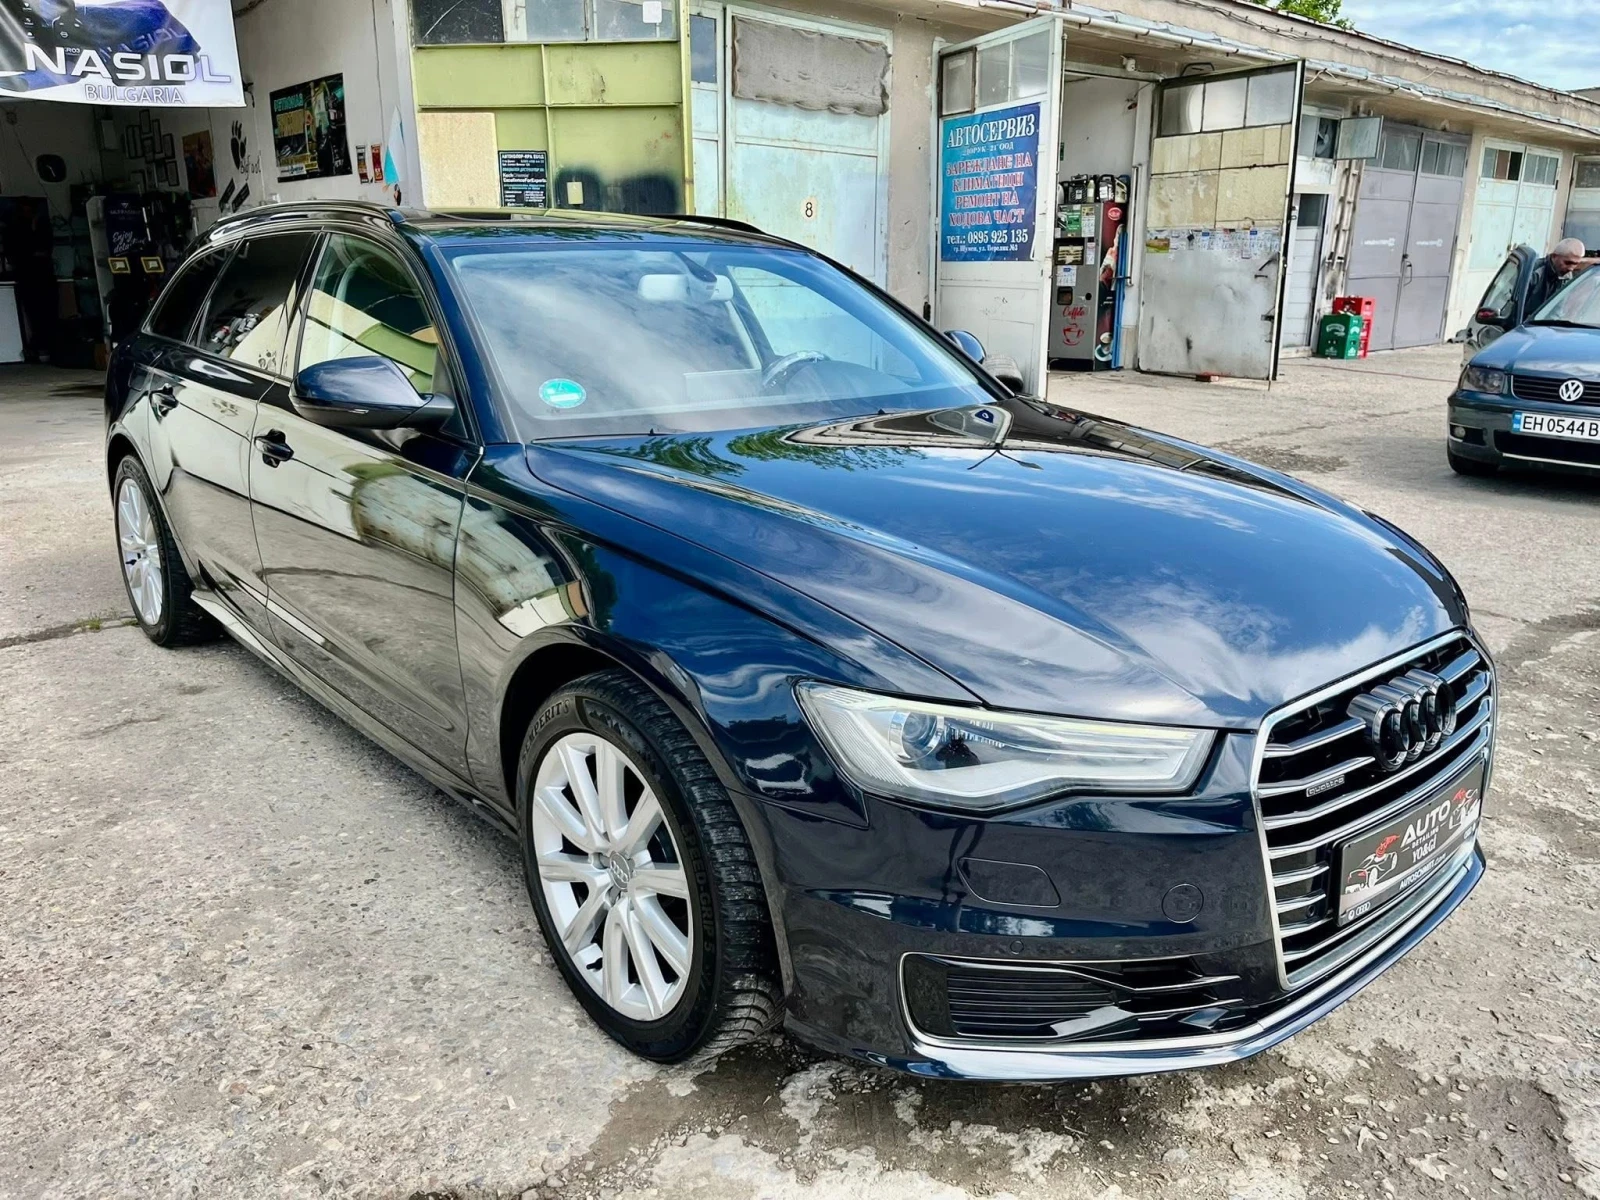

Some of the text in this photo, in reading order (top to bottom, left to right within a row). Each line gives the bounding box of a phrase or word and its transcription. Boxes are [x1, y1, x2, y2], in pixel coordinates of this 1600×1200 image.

[24, 42, 232, 83] NASIOL
[84, 84, 186, 105] BULGARIA
[946, 113, 1036, 148] АВТОСЕРВИЗ
[946, 151, 1033, 176] ЗАРЕЖДАНЕ НА
[952, 172, 1025, 193] КЛИМАТИЦИ
[805, 201, 813, 217] 8
[955, 190, 1019, 209] РЕМОНТ НА
[949, 208, 1025, 229] ХОДОВА ЧАСТ
[112, 230, 134, 245] Enjoy
[967, 230, 989, 244] 0895
[990, 229, 1008, 243] 925
[1010, 228, 1029, 243] 135
[1400, 799, 1451, 848] AUTO
